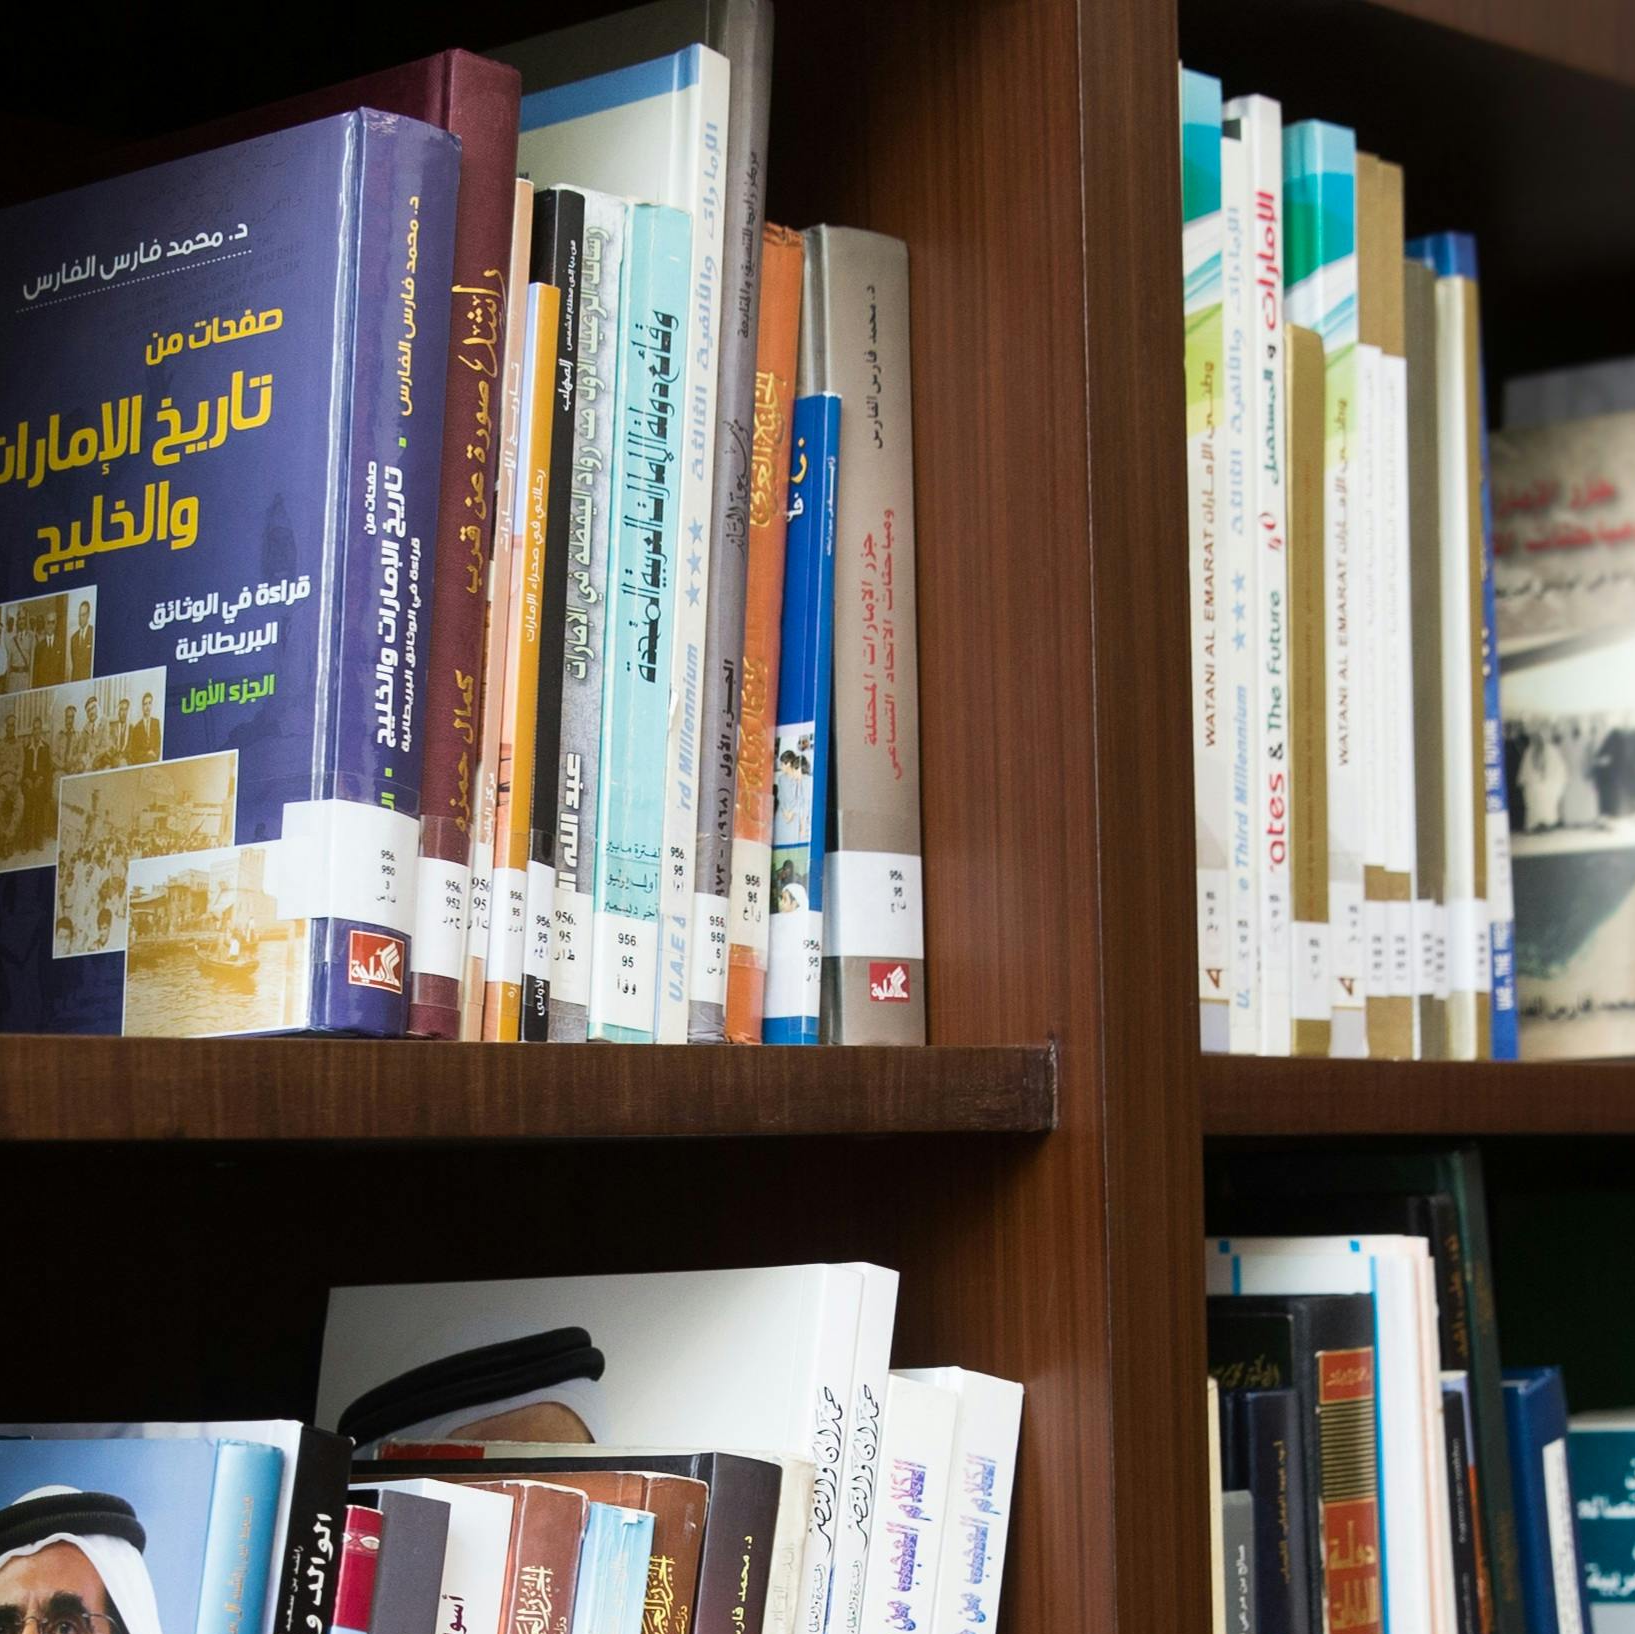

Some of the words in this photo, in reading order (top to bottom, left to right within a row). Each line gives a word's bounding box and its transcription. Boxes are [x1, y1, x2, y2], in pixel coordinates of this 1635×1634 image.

[99, 240, 163, 279] فارس
[167, 232, 224, 258] محمد
[405, 219, 418, 273] محمد
[22, 254, 96, 300] الفارس
[188, 307, 284, 351] صفحات
[401, 278, 416, 338] فارس
[145, 333, 184, 365] من
[397, 341, 413, 416] الفارس
[151, 371, 273, 467] تاريخ
[365, 461, 377, 509] صفحات
[381, 466, 405, 537] تاريخ
[33, 481, 199, 583] والخليج
[365, 512, 377, 535] من
[529, 521, 544, 545] في
[861, 533, 876, 571] جزر
[255, 575, 311, 607] قراءة
[378, 541, 400, 643] الإمارات
[408, 584, 422, 608] في
[1203, 530, 1216, 622] EMARAT
[148, 594, 218, 630] الوثائق
[221, 587, 251, 623] في
[175, 622, 278, 662] البريطانية
[1204, 630, 1216, 657] AL
[1267, 591, 1282, 675] Future
[180, 677, 224, 715] الأول
[229, 675, 275, 702] الجزء
[375, 646, 396, 747] والخليج
[401, 671, 415, 752] البريطانية
[1204, 665, 1216, 747] WATANI
[1268, 686, 1282, 733] The
[563, 753, 583, 809] عبد
[560, 813, 579, 867] الله
[737, 1555, 752, 1601] محمد
